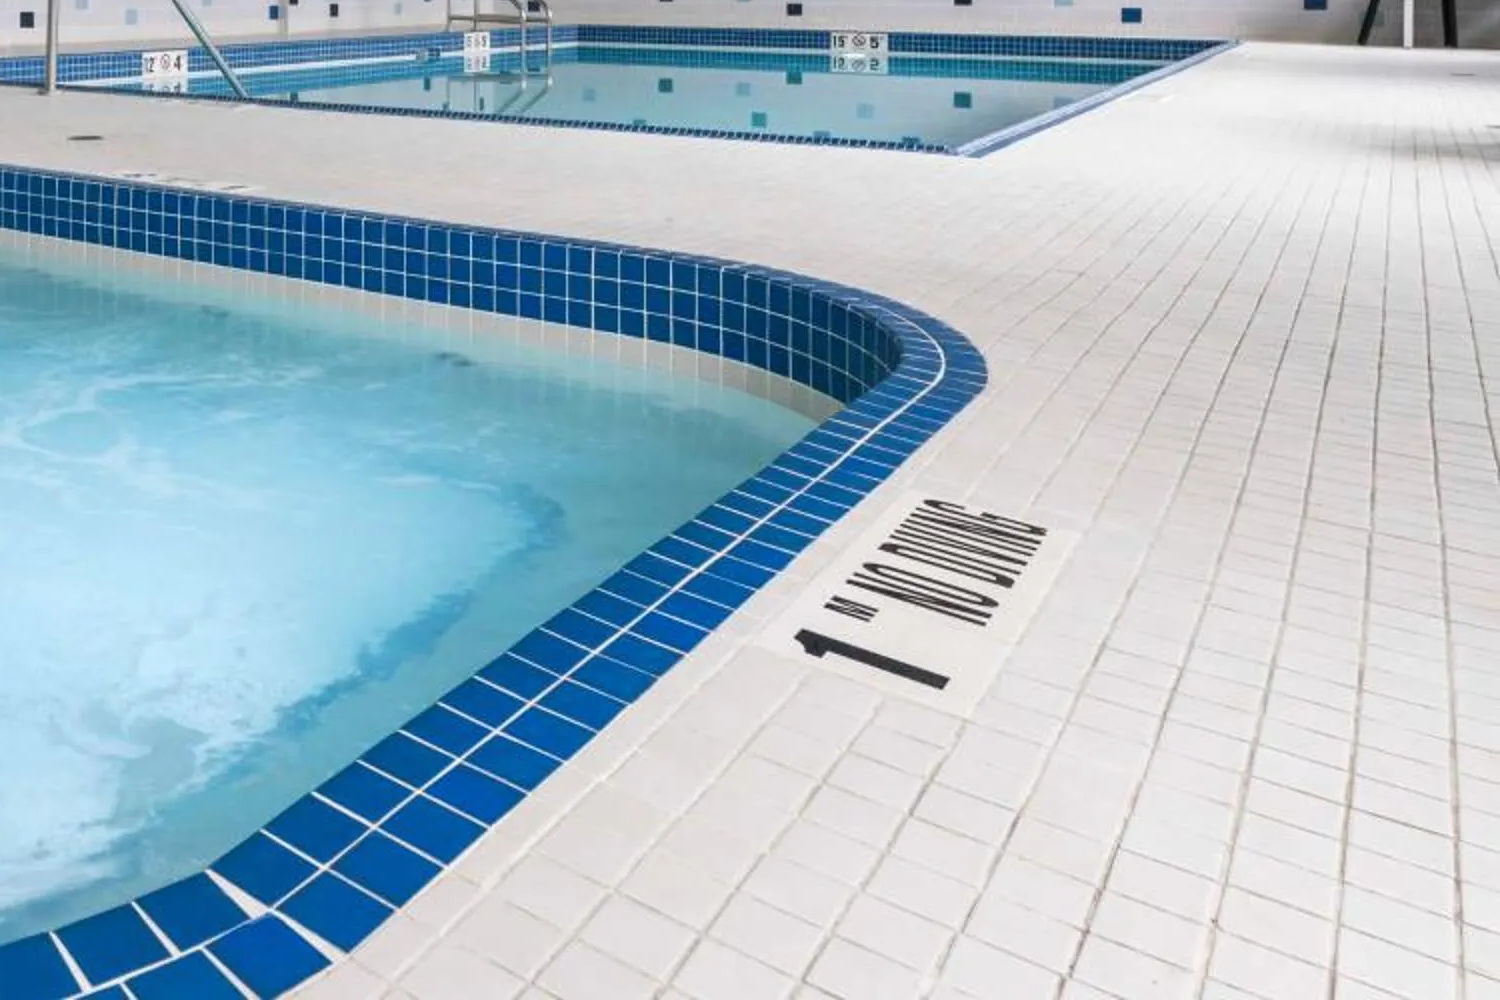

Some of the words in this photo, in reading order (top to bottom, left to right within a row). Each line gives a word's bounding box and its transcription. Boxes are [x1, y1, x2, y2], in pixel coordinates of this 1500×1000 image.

[877, 499, 1048, 588] DIVING
[846, 563, 999, 626] NO
[794, 628, 951, 690] 1
